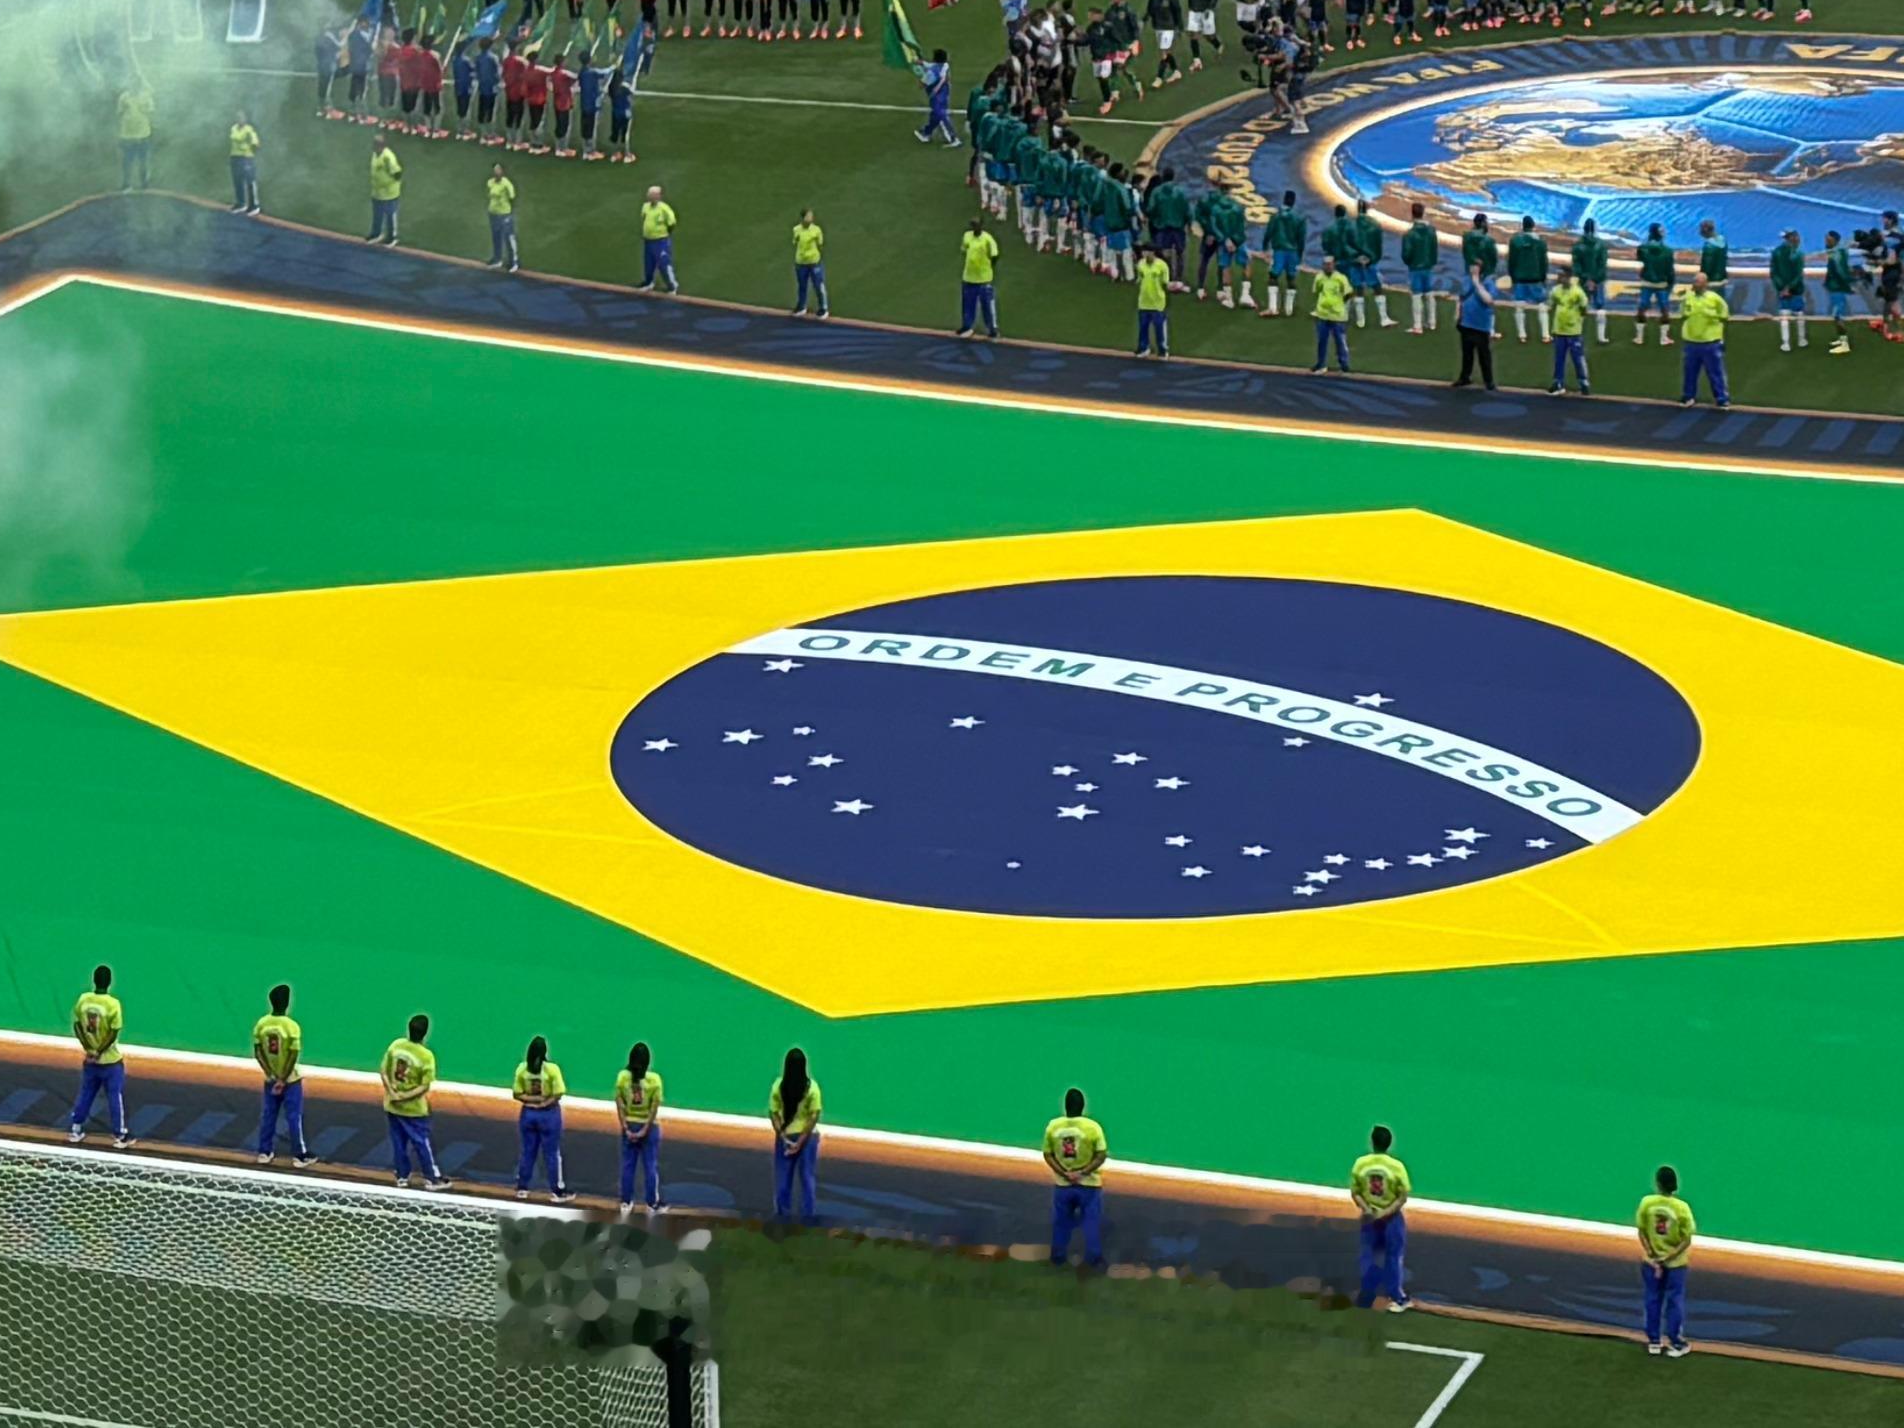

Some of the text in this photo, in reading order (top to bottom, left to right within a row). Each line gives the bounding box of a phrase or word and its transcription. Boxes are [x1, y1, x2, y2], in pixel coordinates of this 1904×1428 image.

[797, 633, 1603, 820] ORDEM E PROGRESSO
